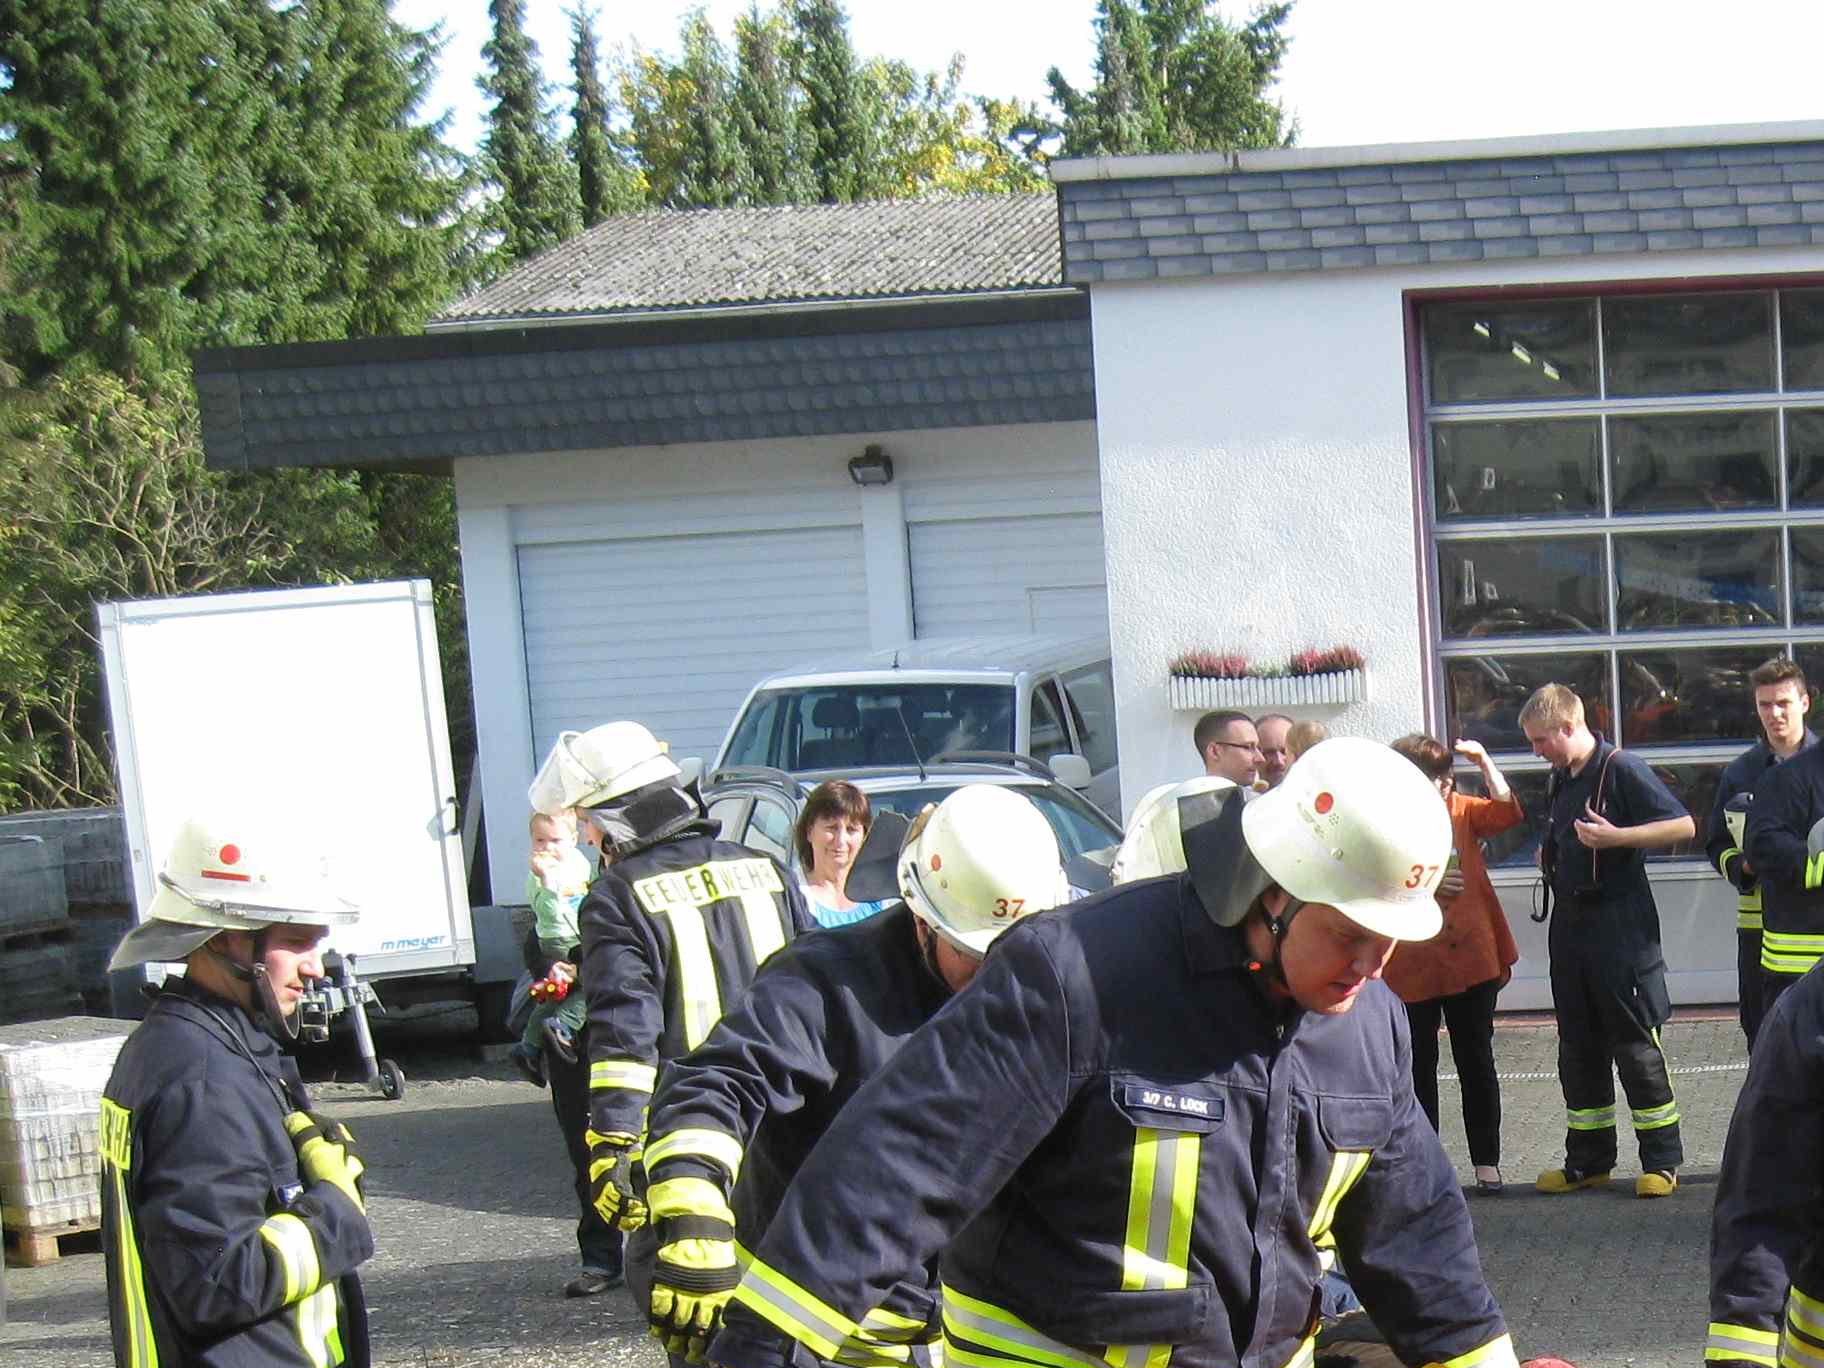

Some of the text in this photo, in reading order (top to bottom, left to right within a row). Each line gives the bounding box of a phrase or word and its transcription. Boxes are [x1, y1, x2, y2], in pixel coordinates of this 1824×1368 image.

[642, 864, 774, 907] FEUERWEHR
[1405, 864, 1439, 889] 37
[992, 898, 1025, 919] 37
[1164, 1095, 1176, 1109] C.
